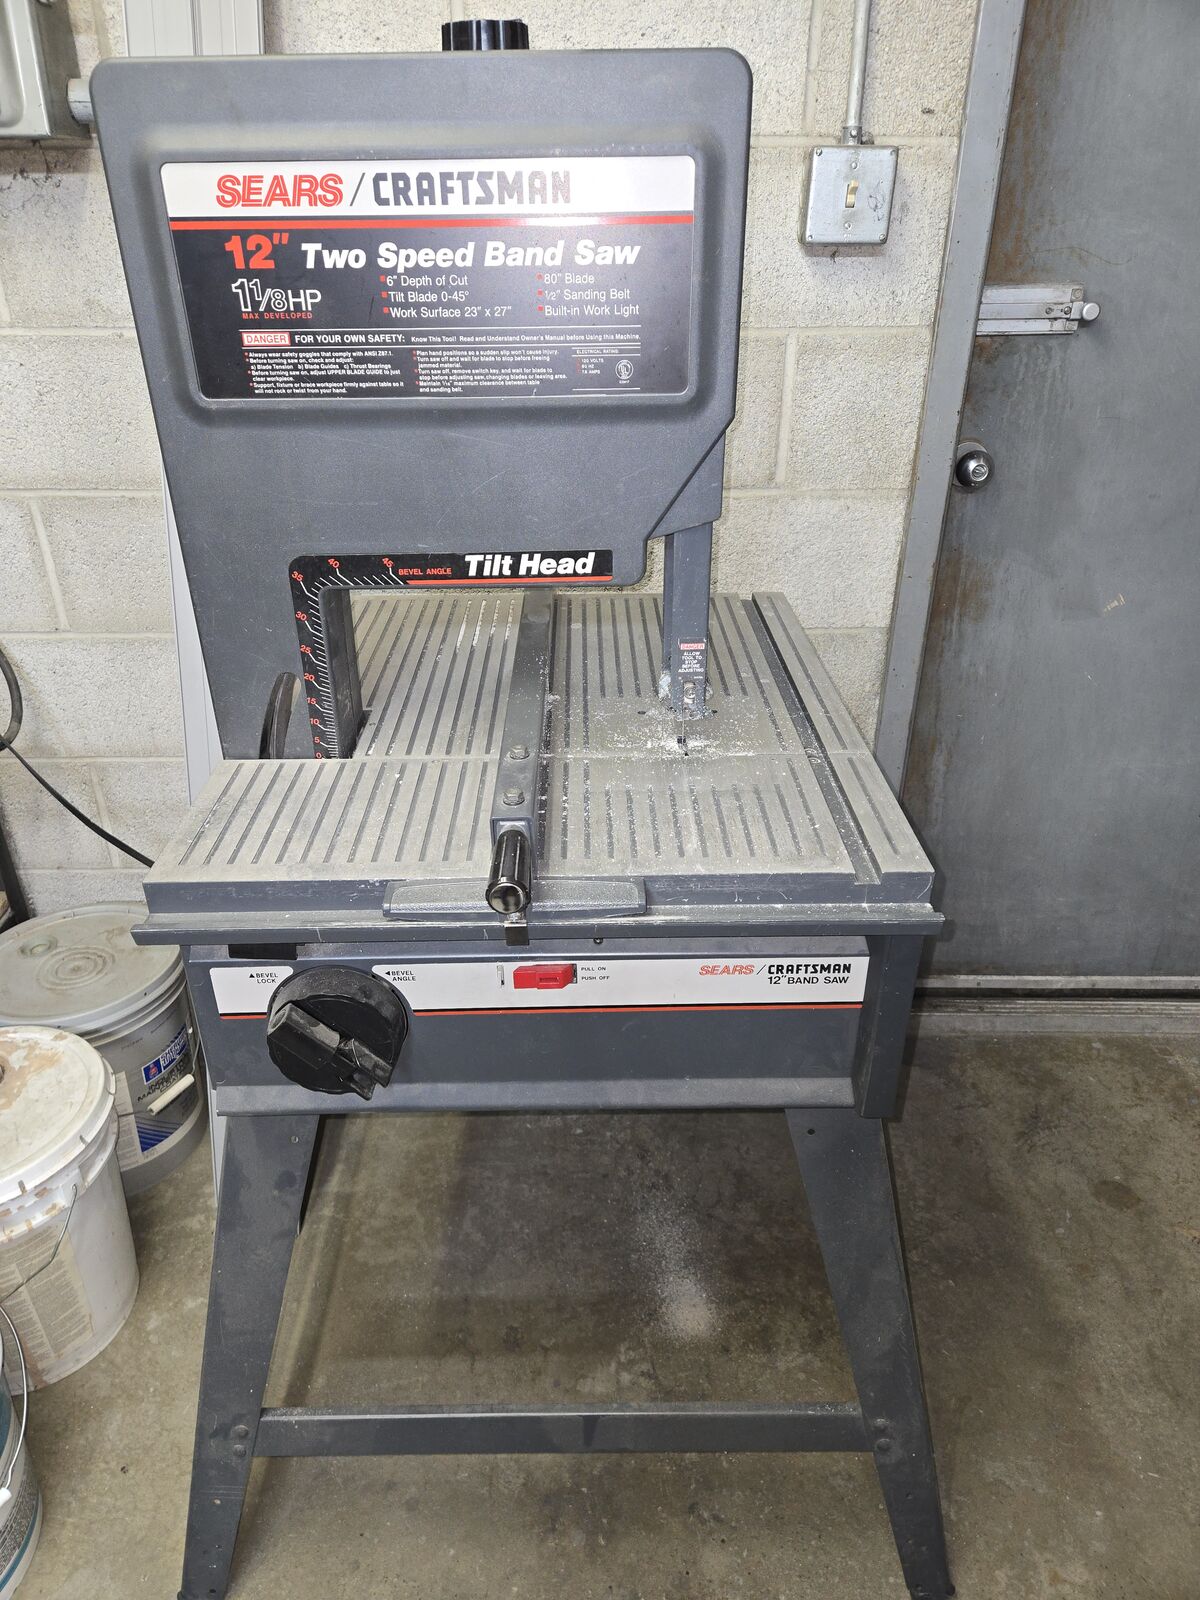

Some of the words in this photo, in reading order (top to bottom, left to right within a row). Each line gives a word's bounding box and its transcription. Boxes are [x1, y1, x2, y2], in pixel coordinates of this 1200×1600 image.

[216, 173, 343, 208] SEARS
[373, 170, 571, 207] CRAFTSMAN
[224, 232, 289, 270] 12"
[301, 242, 367, 269] Two
[377, 241, 476, 273] Speed
[484, 239, 565, 267] Band
[574, 239, 642, 266] Saw
[386, 276, 398, 287] 6"
[400, 275, 433, 288] Depth
[436, 275, 446, 286] of
[449, 274, 469, 286] Cut
[544, 273, 563, 284] 80"
[565, 272, 595, 284] Blade
[388, 291, 405, 303] Tilt
[408, 291, 438, 302] Blade
[563, 288, 606, 302] Sanding
[610, 288, 631, 300] Belt
[390, 307, 418, 319] Work
[420, 306, 461, 318] Surface
[464, 306, 482, 318] 23"
[485, 308, 491, 317] x
[494, 306, 512, 317] 27"
[544, 305, 580, 317] Built-in
[584, 304, 611, 316] Work
[614, 303, 640, 317] Light
[246, 334, 287, 344] DANGER
[295, 335, 314, 344] FOR
[316, 335, 342, 343] YOUR
[344, 334, 366, 343] OWN
[367, 334, 406, 343] SAFETY:
[586, 334, 602, 342] Using
[328, 558, 340, 569] 40
[382, 557, 394, 568] 45
[398, 567, 424, 576] BEVEL
[426, 566, 452, 575] ANGLE
[464, 552, 515, 577] Tilt
[518, 551, 596, 576] Head
[291, 570, 304, 582] 35
[295, 611, 307, 621] 30
[300, 644, 312, 654] 25
[304, 672, 315, 682] 20
[307, 697, 317, 705] 15
[314, 736, 320, 744] 5
[316, 751, 322, 759] 0
[699, 964, 755, 976] SEARS
[767, 963, 852, 975] CRAFTSMAN
[767, 975, 787, 985] 12"
[787, 976, 820, 985] BAND
[823, 976, 850, 984] SAW
